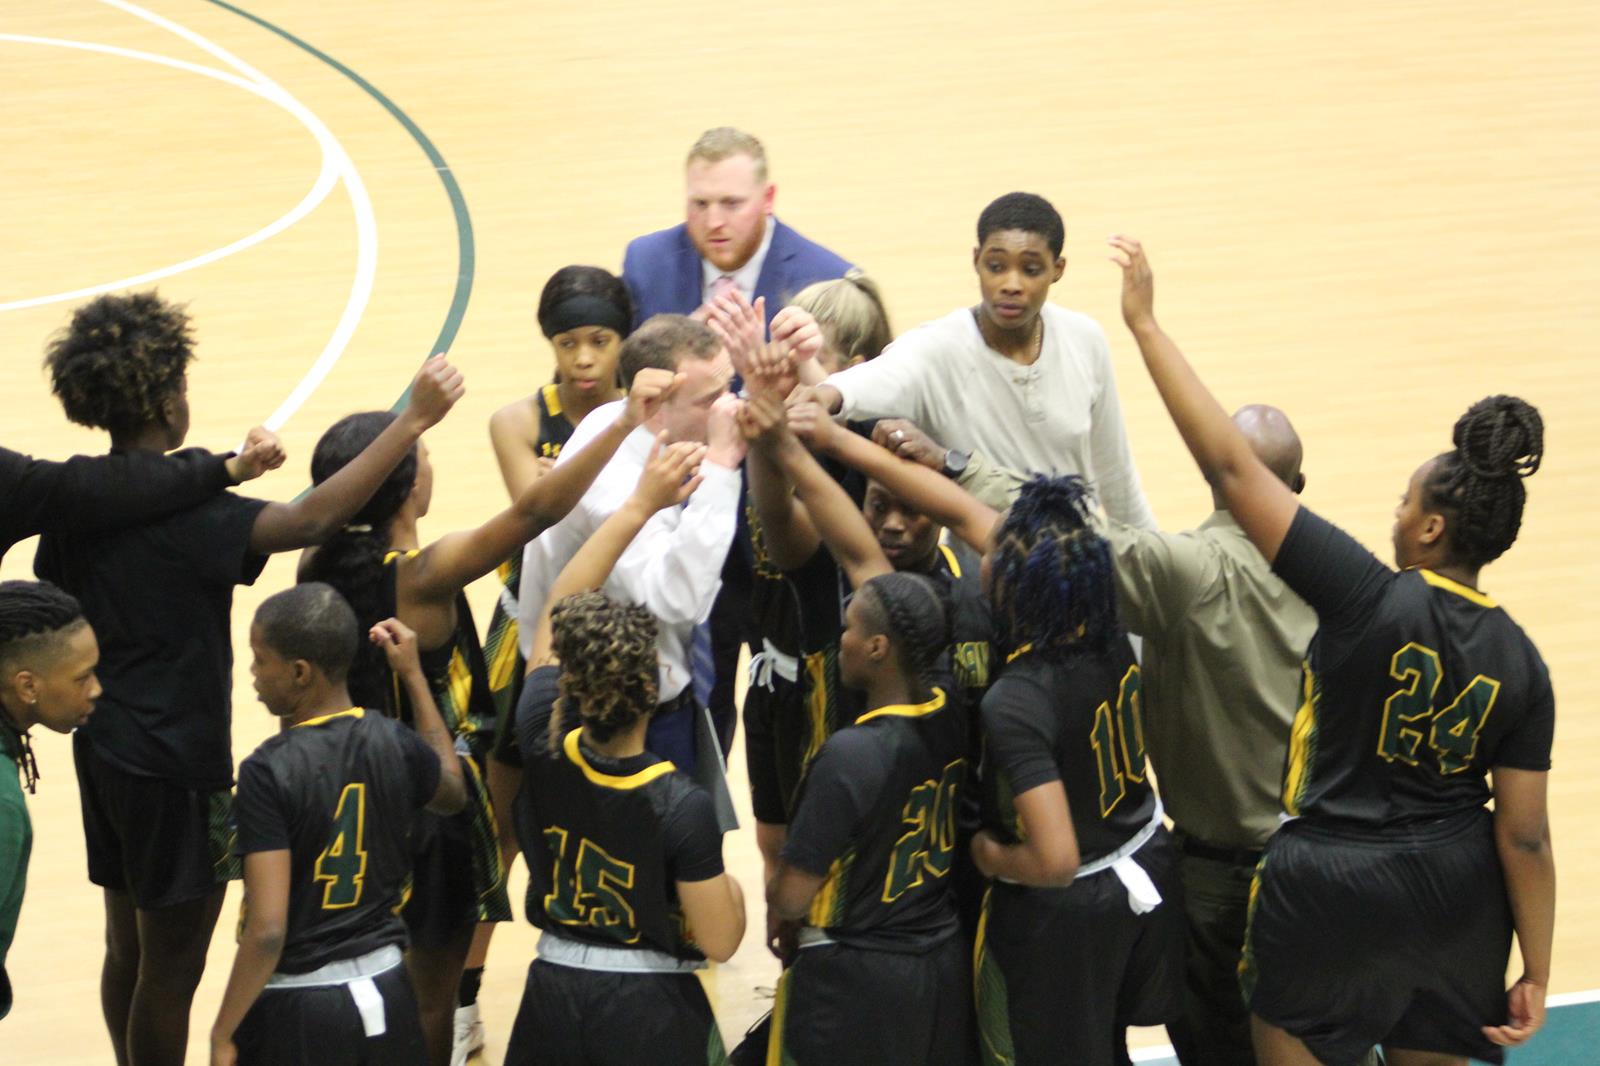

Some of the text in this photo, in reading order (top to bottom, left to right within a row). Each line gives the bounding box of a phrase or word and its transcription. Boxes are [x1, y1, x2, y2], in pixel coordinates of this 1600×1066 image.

[1090, 663, 1147, 818] 10
[1377, 641, 1500, 775] 24
[313, 783, 367, 910] 4
[543, 825, 642, 944] 15
[881, 757, 966, 903] 20
